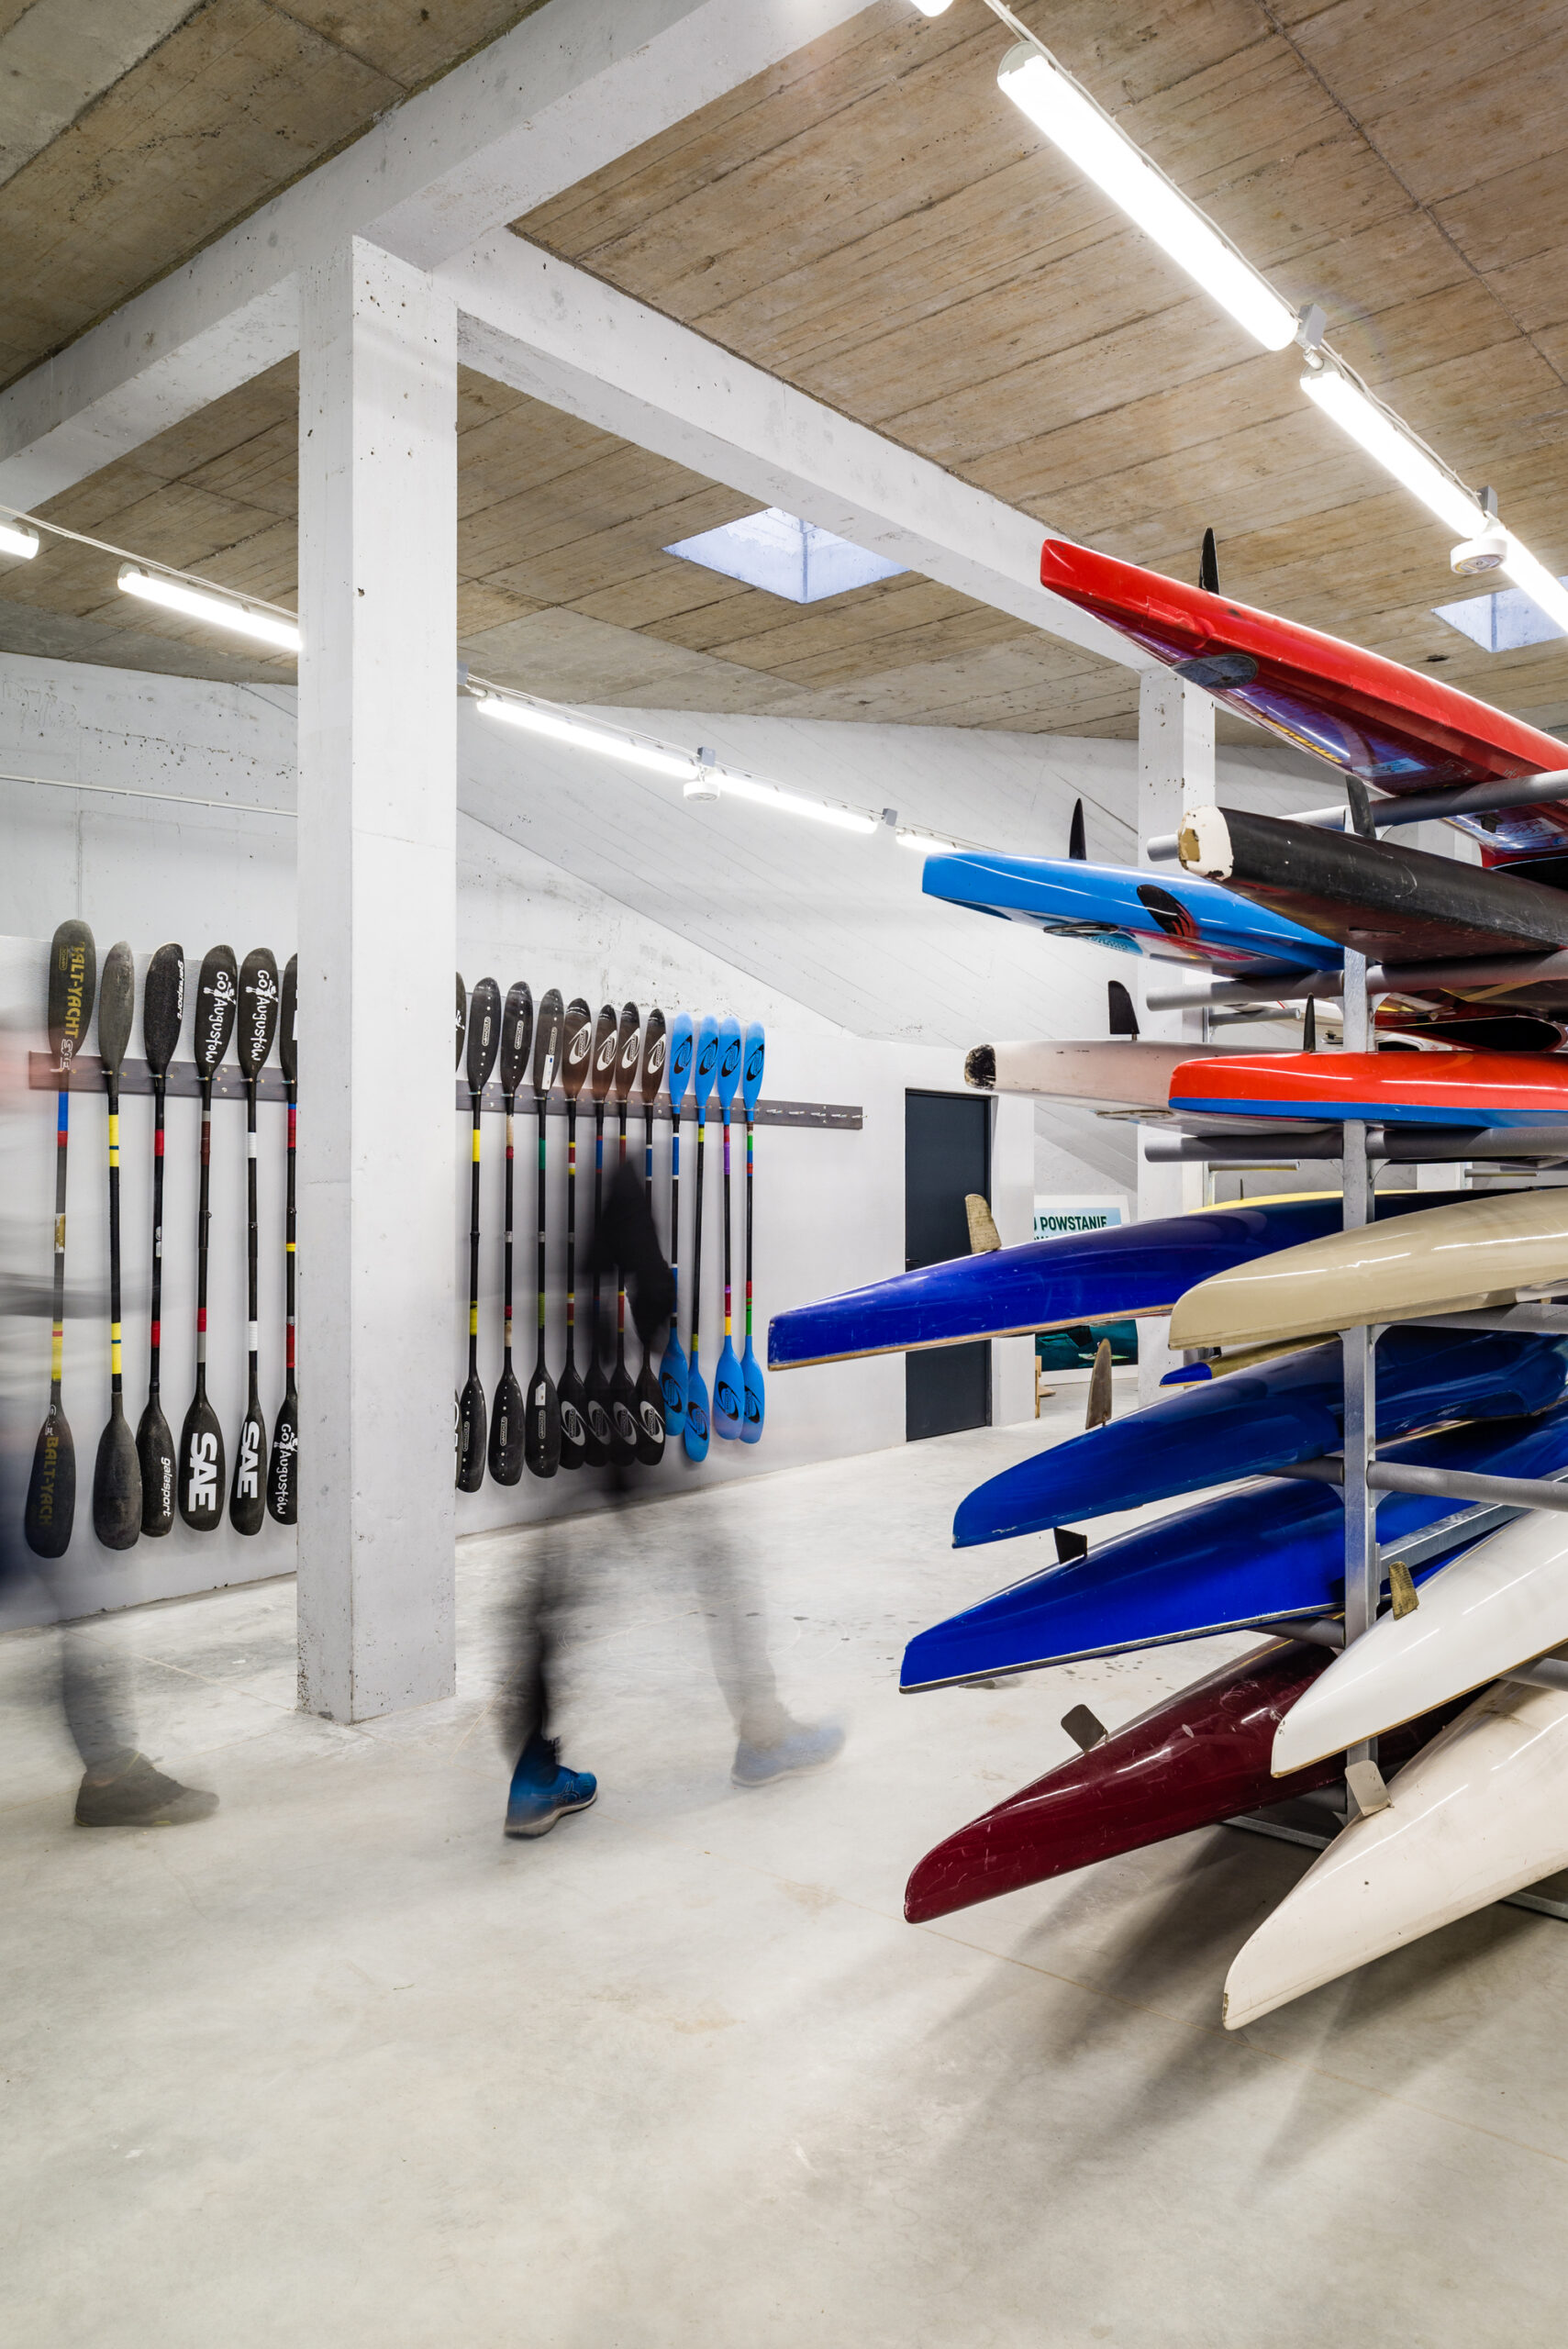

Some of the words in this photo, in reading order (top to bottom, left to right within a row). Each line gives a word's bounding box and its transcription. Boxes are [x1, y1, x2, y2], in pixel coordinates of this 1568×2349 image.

[250, 996, 271, 1062] Augustów
[161, 1456, 172, 1518] galasport
[188, 1431, 218, 1512] SAE
[237, 1420, 260, 1498] SAE
[274, 1450, 292, 1515] Augustów
